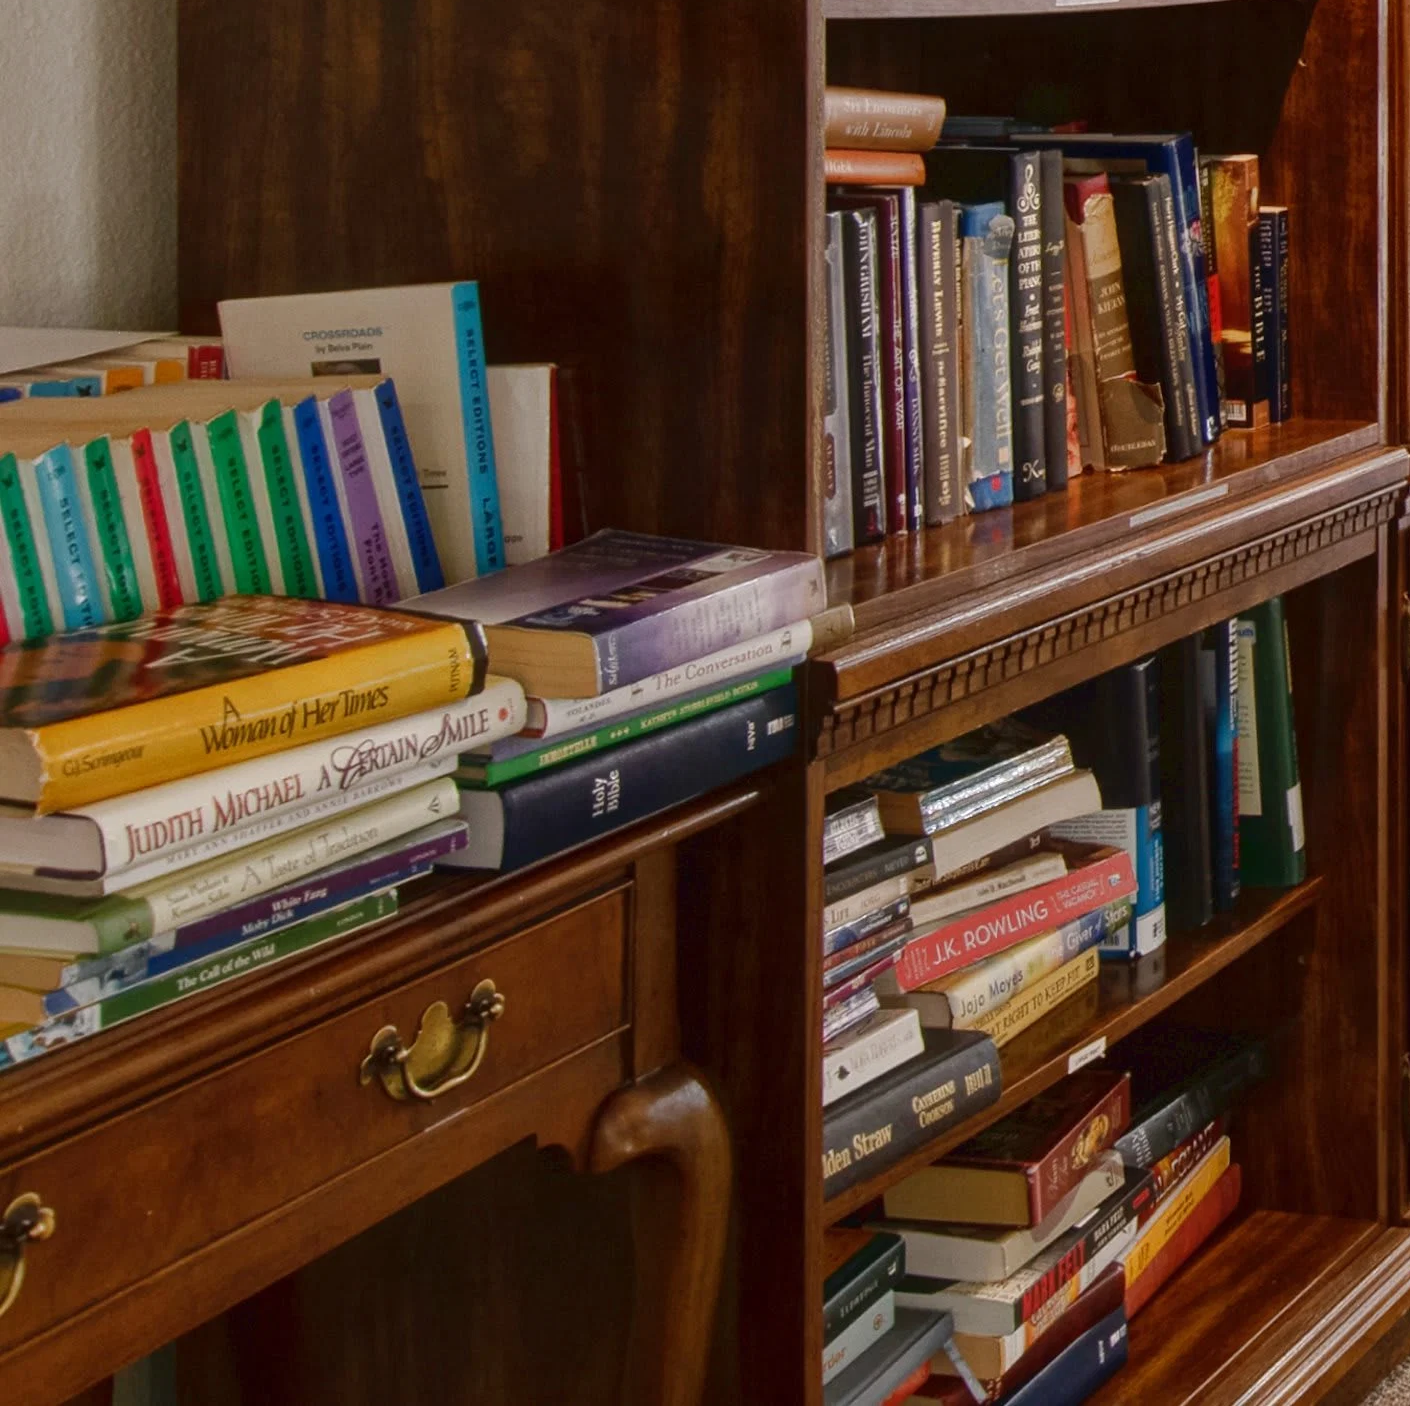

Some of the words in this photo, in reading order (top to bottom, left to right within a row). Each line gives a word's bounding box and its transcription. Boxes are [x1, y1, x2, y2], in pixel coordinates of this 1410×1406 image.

[845, 121, 869, 136] with
[872, 121, 913, 139] Lincoln
[859, 221, 872, 262] JOHN
[930, 220, 943, 285] BEVERLY
[1170, 253, 1181, 276] Clark
[860, 265, 872, 338] GRISHAM
[991, 257, 1010, 321] Let's
[303, 326, 383, 341] CROSSROADS
[891, 317, 901, 344] THE
[933, 291, 945, 337] LEWIS
[1253, 297, 1266, 363] BIBLE
[315, 345, 326, 355] by
[327, 343, 351, 354] Belva
[352, 341, 373, 352] Plain
[465, 329, 481, 390] SELECT
[861, 351, 873, 378] The
[892, 348, 902, 374] ART
[994, 326, 1011, 374] Get
[863, 379, 875, 436] Innocent
[893, 377, 903, 395] OF
[995, 381, 1013, 437] Well
[470, 395, 489, 475] EDITIONS
[894, 398, 904, 430] WAR
[938, 377, 950, 448] Sacrifice
[864, 438, 876, 468] Man
[101, 489, 121, 556] SELECT
[183, 472, 203, 537] SELECT
[228, 457, 249, 522] SELECT
[241, 529, 263, 595] EDITIO
[271, 445, 290, 508] SELECT
[285, 514, 308, 595] EDITION
[311, 445, 330, 508] SELECT
[324, 514, 348, 593] EDITIONS
[11, 508, 33, 578] SELECT
[60, 498, 82, 565] SELECT
[481, 497, 499, 568] LARGE
[447, 647, 459, 695] PUTNAM
[652, 673, 683, 692] The
[685, 643, 774, 681] Conversation
[200, 716, 277, 756] Woman
[279, 709, 298, 745] of
[302, 696, 341, 730] Her
[339, 685, 390, 719] Times
[222, 695, 241, 724] A
[124, 811, 205, 865] JUDITH
[211, 773, 307, 837] MICHAEL
[315, 764, 333, 792] A
[330, 730, 420, 791] CERTAIN
[417, 707, 491, 760] SMILE
[592, 777, 608, 819] Holy
[606, 768, 621, 813] Bible
[166, 847, 203, 866] MARY
[204, 840, 230, 855] ANN
[230, 820, 284, 845] SHAFFER
[287, 809, 311, 825] AND
[314, 795, 349, 817] ANNIE
[351, 775, 405, 801] BARROWS
[240, 865, 262, 893] A
[264, 853, 300, 882] Taste
[303, 840, 317, 869] of
[316, 824, 380, 857] Tradition
[241, 917, 270, 937] Moby
[271, 908, 295, 925] Dick
[272, 895, 302, 912] White
[303, 887, 329, 904] Fang
[932, 939, 962, 967] J.K.
[962, 898, 1050, 951] ROWLING
[1065, 926, 1094, 950] Giver
[1103, 903, 1129, 925] Stars
[176, 974, 198, 991] The
[199, 965, 221, 983] Call
[221, 959, 234, 975] of
[233, 954, 251, 970] the
[251, 943, 277, 962] Wild
[960, 995, 986, 1019] Jojo
[988, 969, 1025, 1000] Moyes
[1001, 1003, 1030, 1032] RIGHT
[1031, 995, 1044, 1012] TO
[1044, 978, 1067, 1001] KEEP
[1067, 965, 1082, 984] FIT
[918, 1098, 956, 1129] COOKSON
[851, 1123, 894, 1161] Straw
